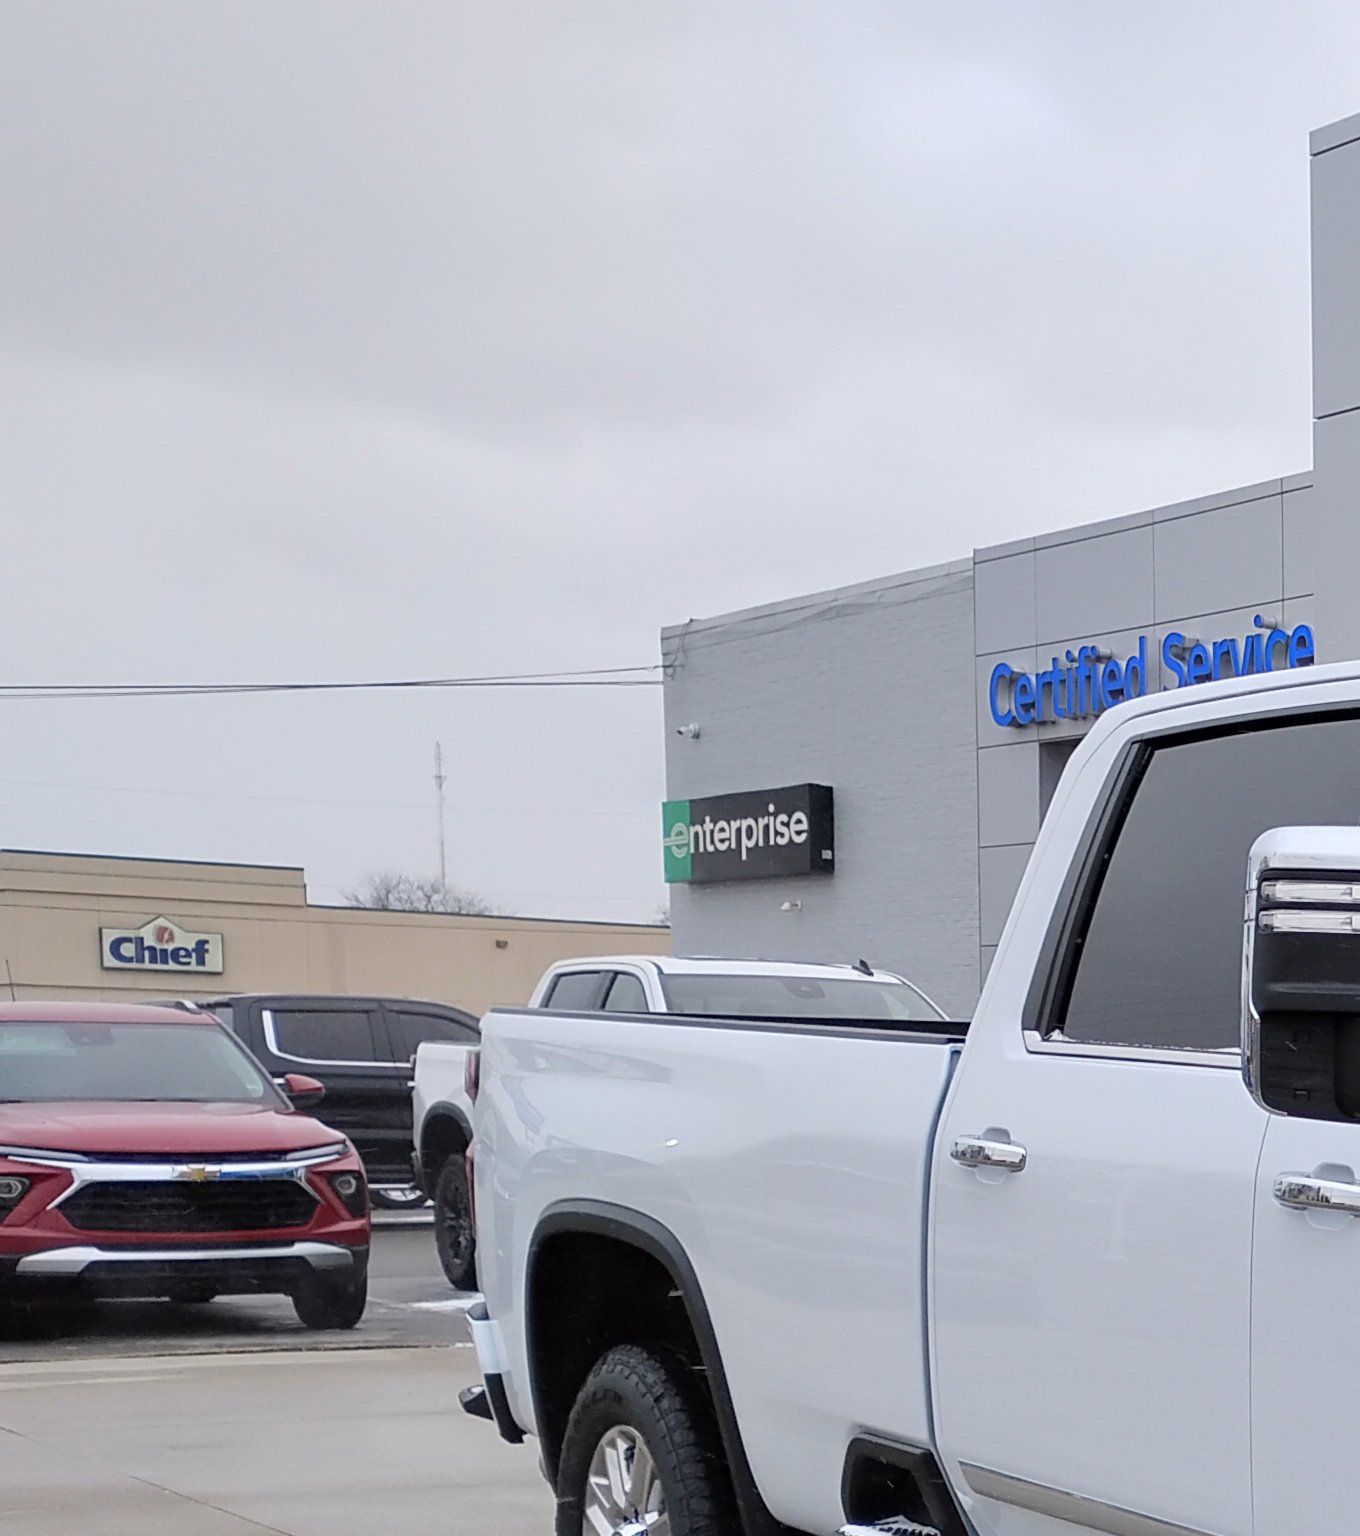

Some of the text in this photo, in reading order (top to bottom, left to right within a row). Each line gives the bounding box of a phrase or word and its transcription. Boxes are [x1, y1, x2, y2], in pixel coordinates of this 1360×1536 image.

[990, 614, 1315, 727] Certified Service
[664, 803, 808, 861] enterprise
[109, 936, 210, 967] Chief
